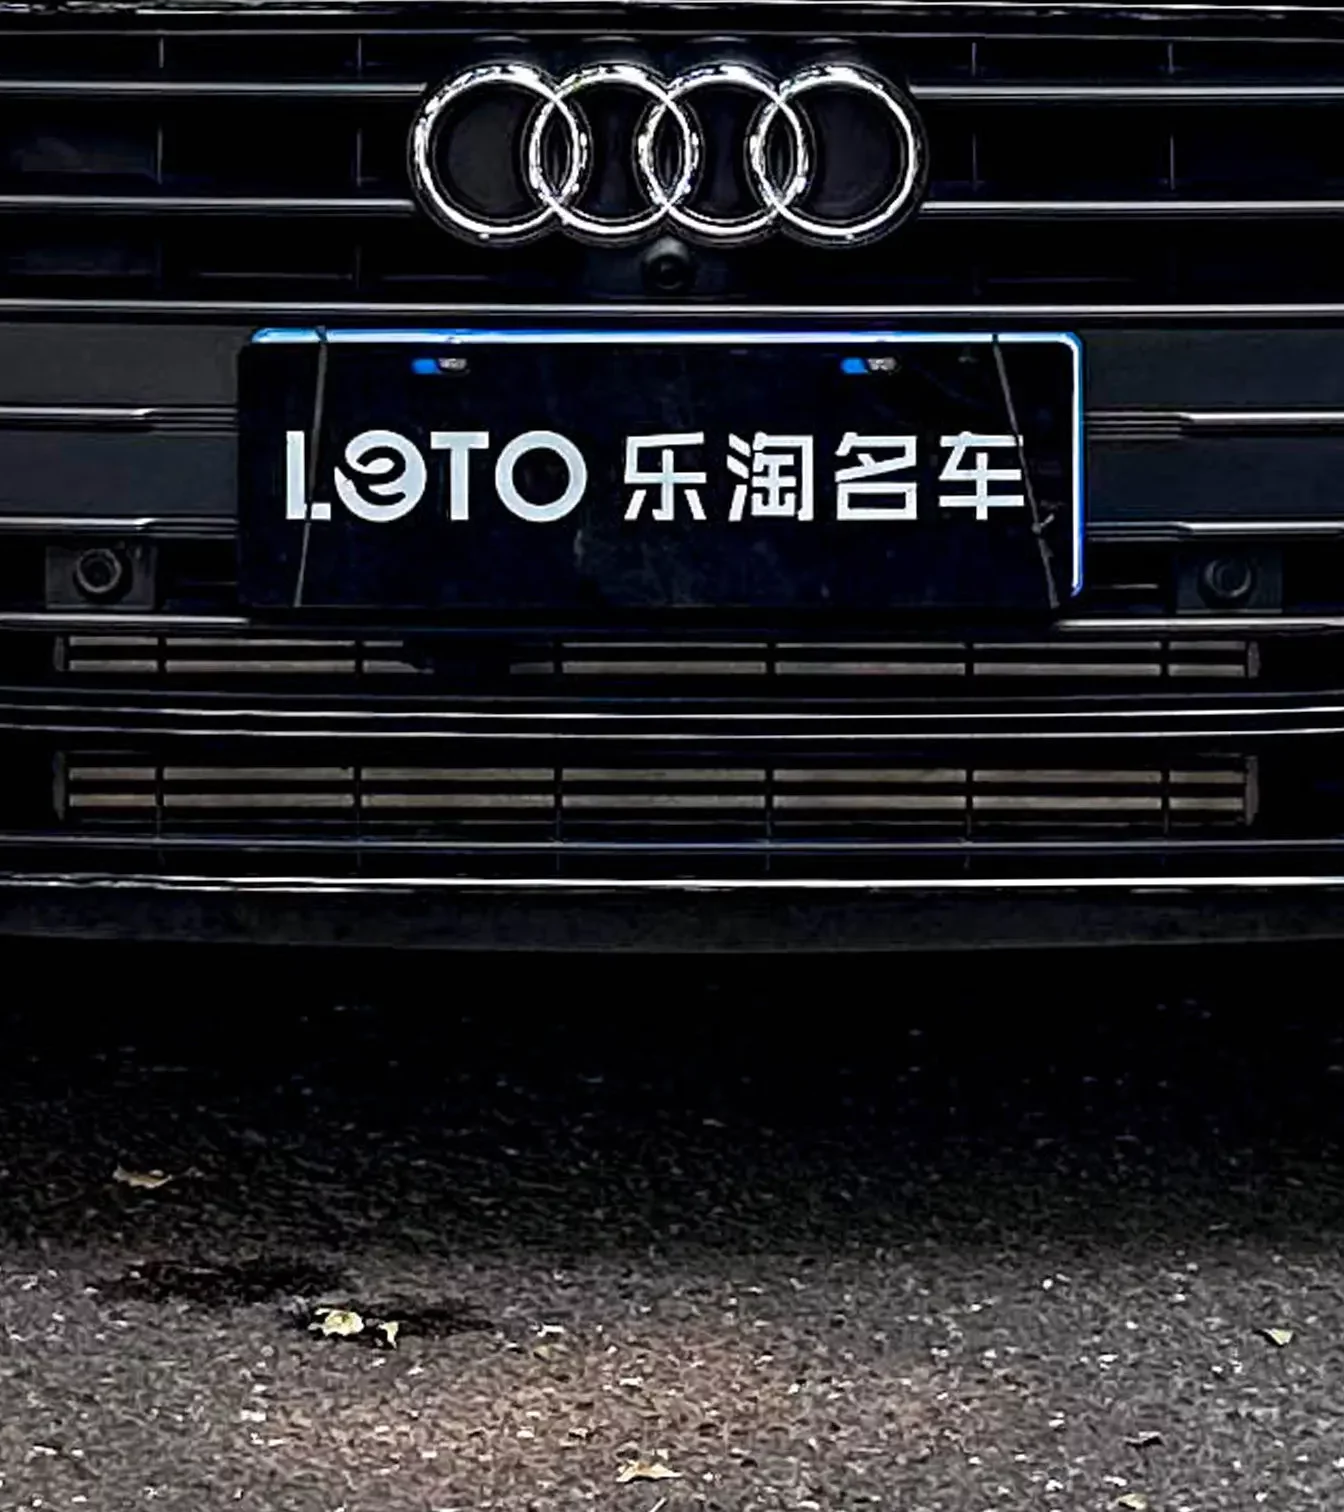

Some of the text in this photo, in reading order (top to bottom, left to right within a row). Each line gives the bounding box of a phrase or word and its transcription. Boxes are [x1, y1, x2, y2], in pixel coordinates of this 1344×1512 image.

[285, 429, 1024, 522] LOTO 乐淘名车
